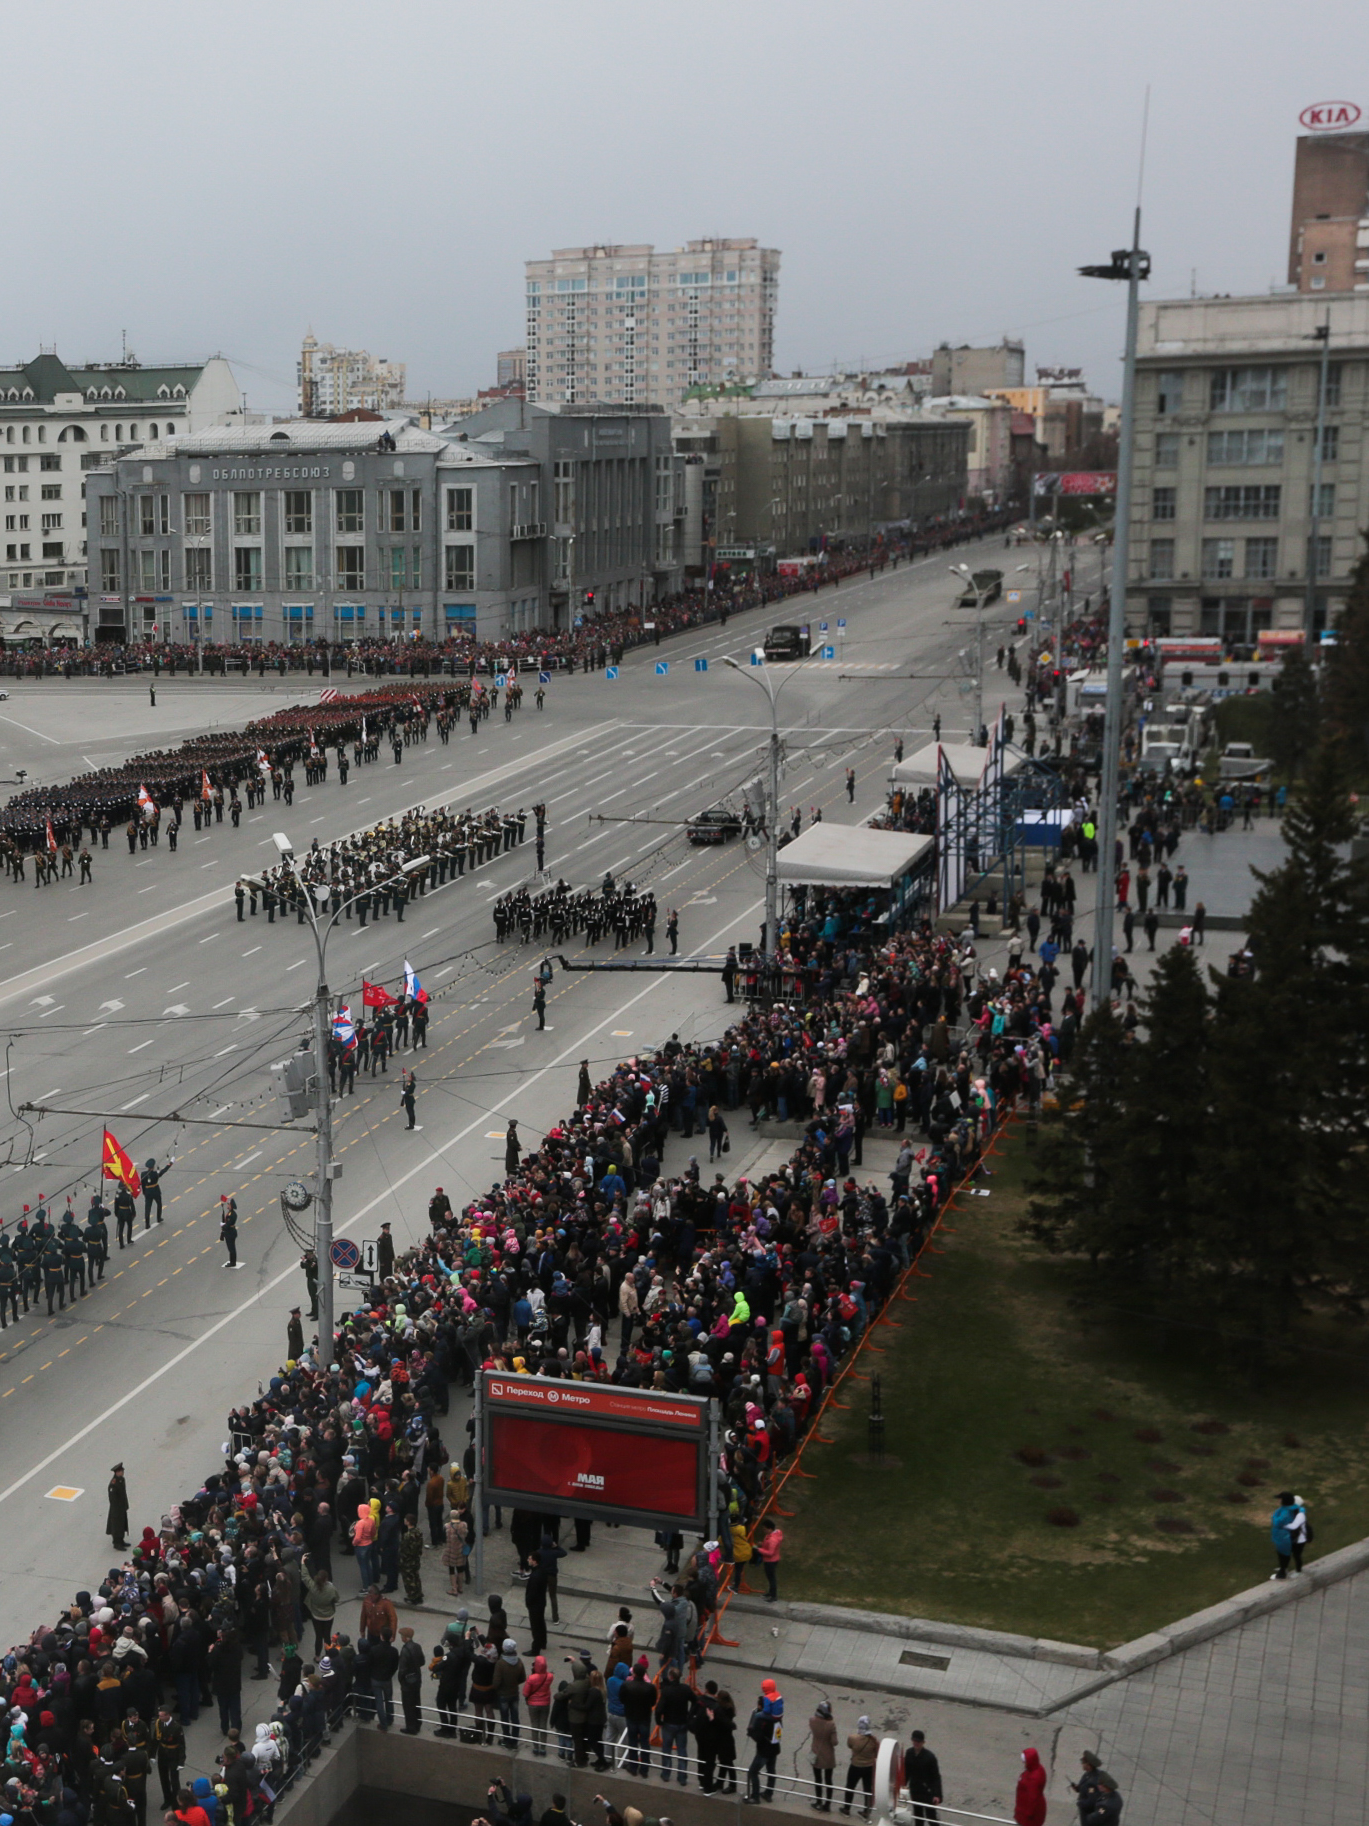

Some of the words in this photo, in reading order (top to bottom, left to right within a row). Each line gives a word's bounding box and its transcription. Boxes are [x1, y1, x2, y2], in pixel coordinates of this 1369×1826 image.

[1310, 108, 1350, 124] KIA
[212, 466, 331, 481] ОБЛПОТРЕБСОЮЗ
[506, 1385, 545, 1399] Переход
[561, 1393, 591, 1404] Метро
[647, 1406, 674, 1416] Площадь
[674, 1410, 697, 1418] Ленина
[577, 1473, 605, 1485] МАЯ
